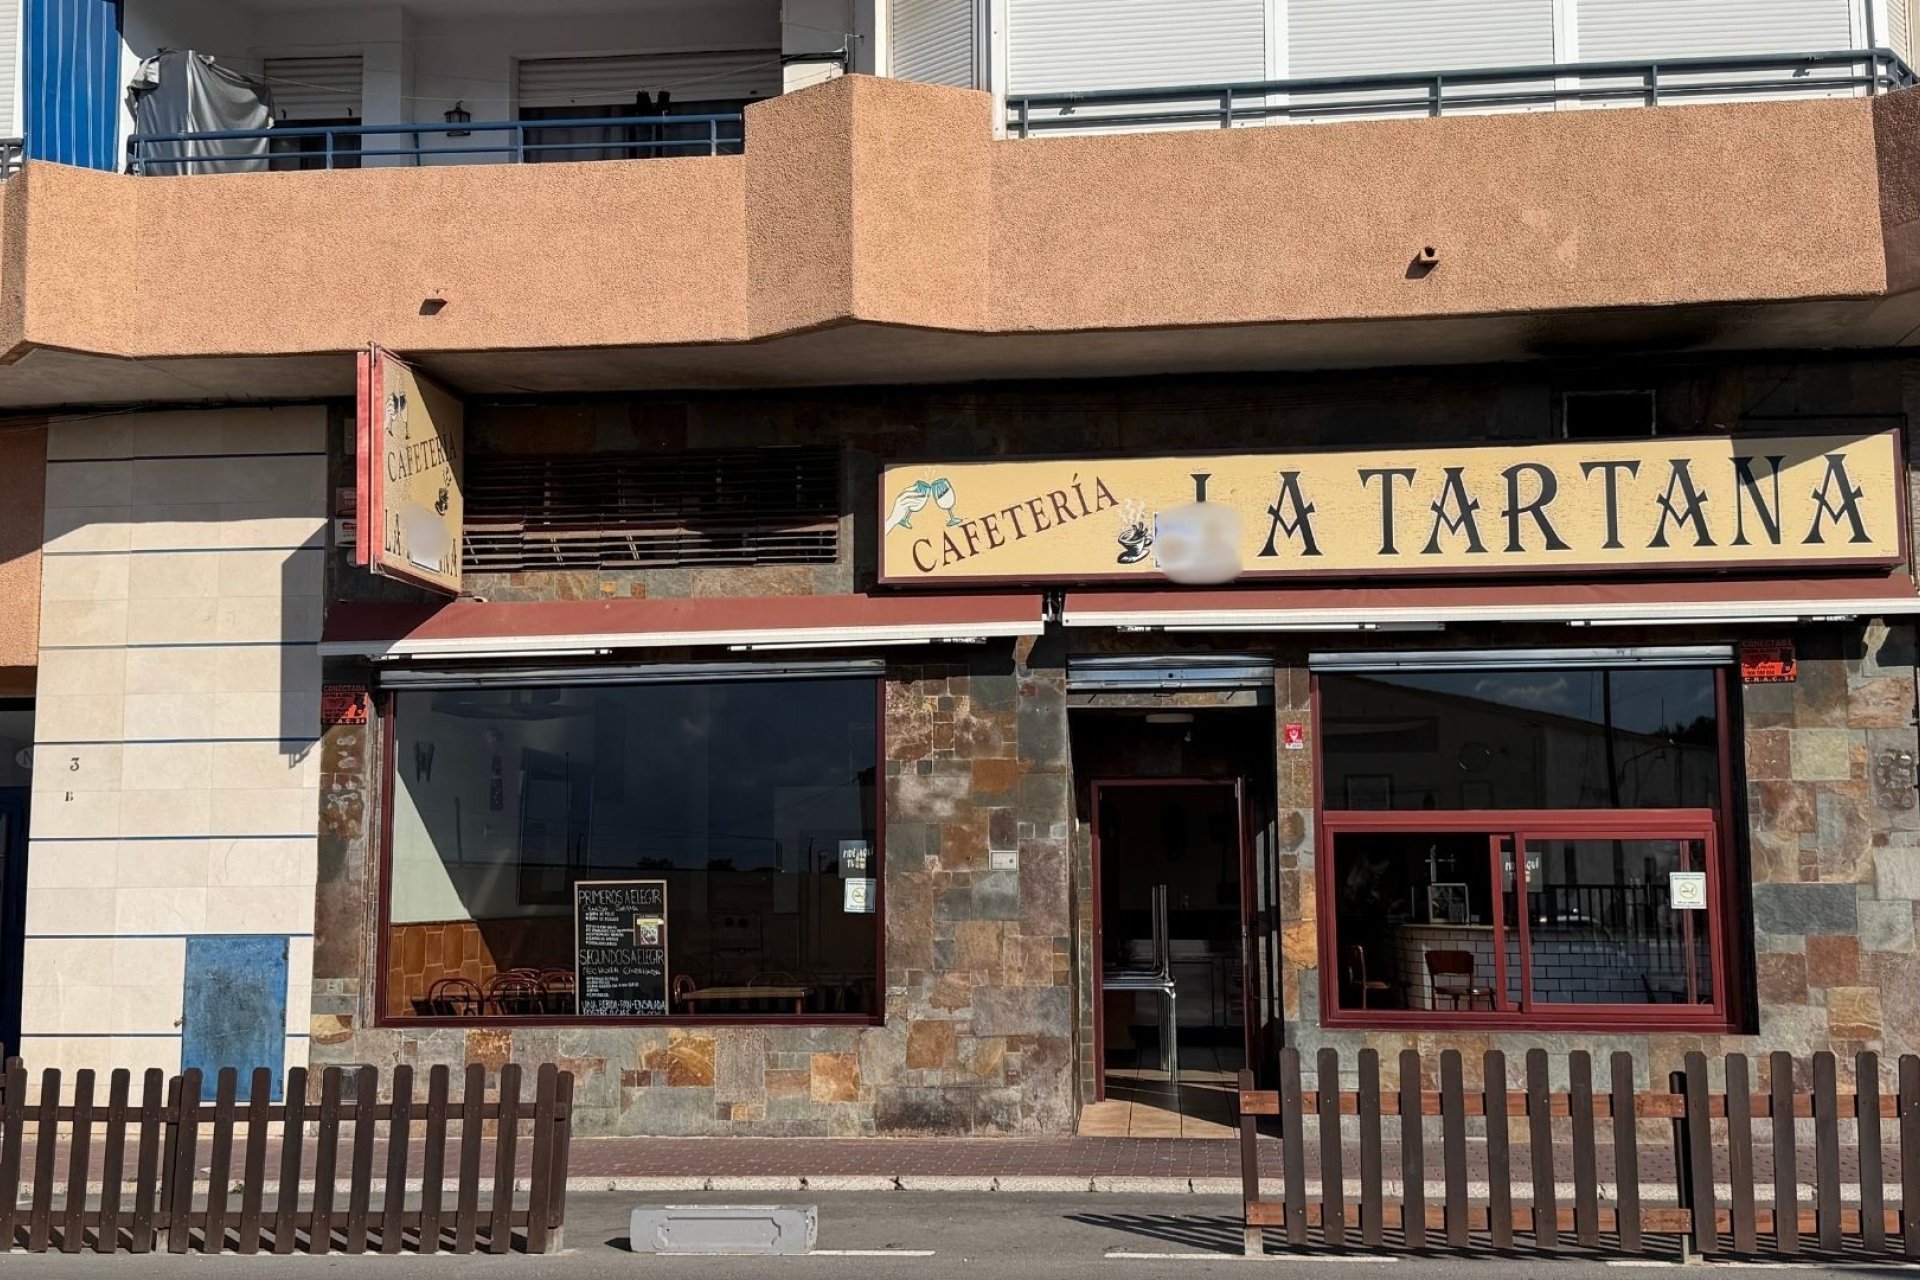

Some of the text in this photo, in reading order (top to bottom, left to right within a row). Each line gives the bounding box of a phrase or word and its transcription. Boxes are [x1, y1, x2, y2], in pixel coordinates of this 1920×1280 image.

[387, 425, 457, 483] CAFETERÍA
[911, 472, 1119, 573] CAFETERÍA
[1358, 453, 1873, 556] TARTANA
[70, 757, 80, 771] 3
